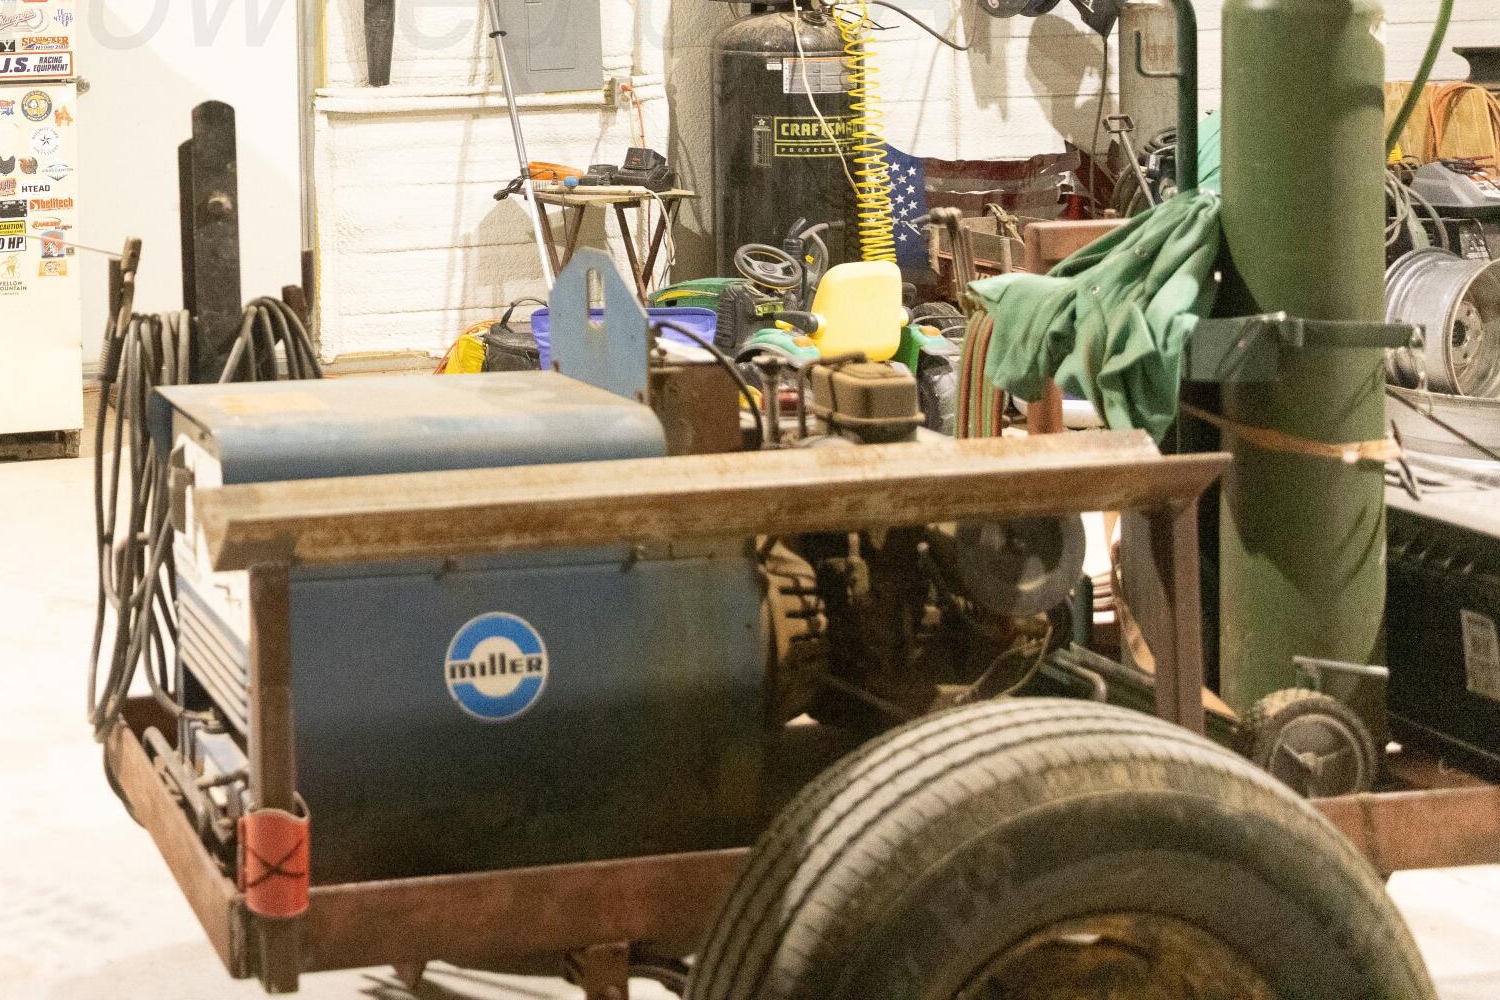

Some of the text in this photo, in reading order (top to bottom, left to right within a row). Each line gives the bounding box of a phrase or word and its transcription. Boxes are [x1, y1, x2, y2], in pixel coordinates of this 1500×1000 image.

[39, 56, 63, 64] RACING
[33, 64, 68, 72] EQUIPMENT
[41, 197, 73, 209] belltech
[8, 236, 24, 249] HP
